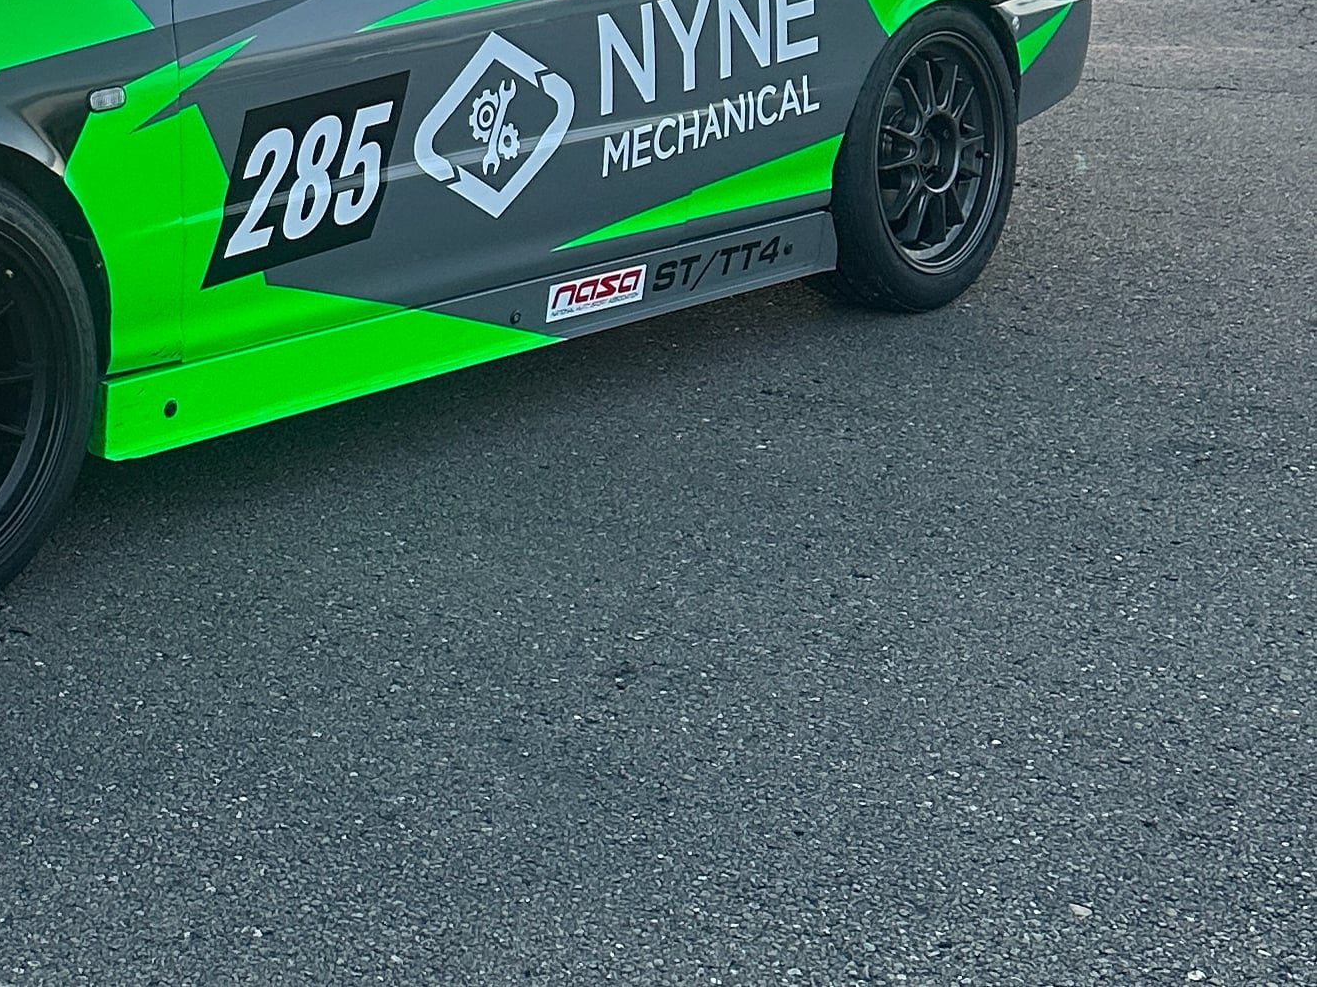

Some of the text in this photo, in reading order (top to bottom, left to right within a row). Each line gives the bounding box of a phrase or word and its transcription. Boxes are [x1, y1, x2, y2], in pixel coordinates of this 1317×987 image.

[601, 74, 821, 177] MECHANICAL
[224, 100, 394, 259] 285
[652, 236, 781, 292] ST/TT4
